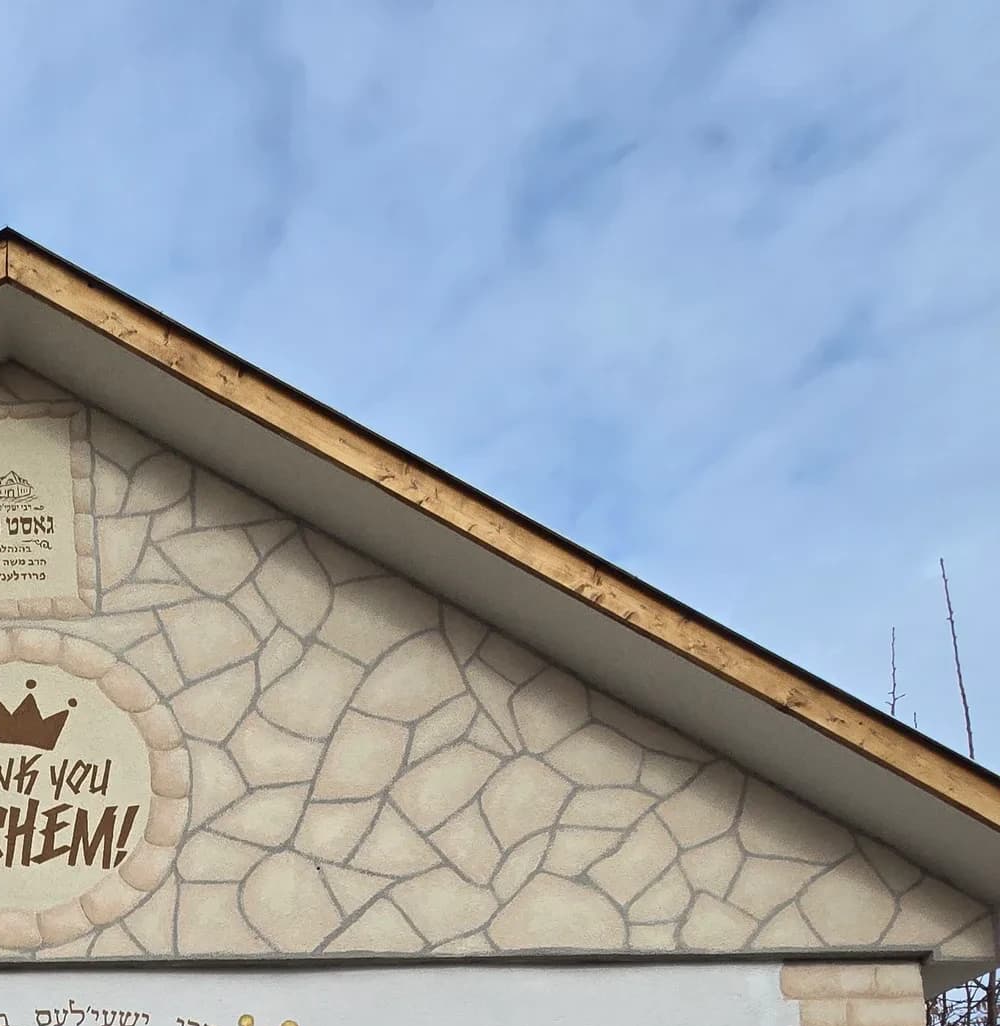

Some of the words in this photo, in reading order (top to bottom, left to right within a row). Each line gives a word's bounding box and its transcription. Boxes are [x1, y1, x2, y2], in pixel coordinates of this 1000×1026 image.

[6, 515, 54, 535] גאסט
[3, 558, 26, 566] משה
[28, 558, 47, 566] הרב
[49, 758, 112, 801] YOU
